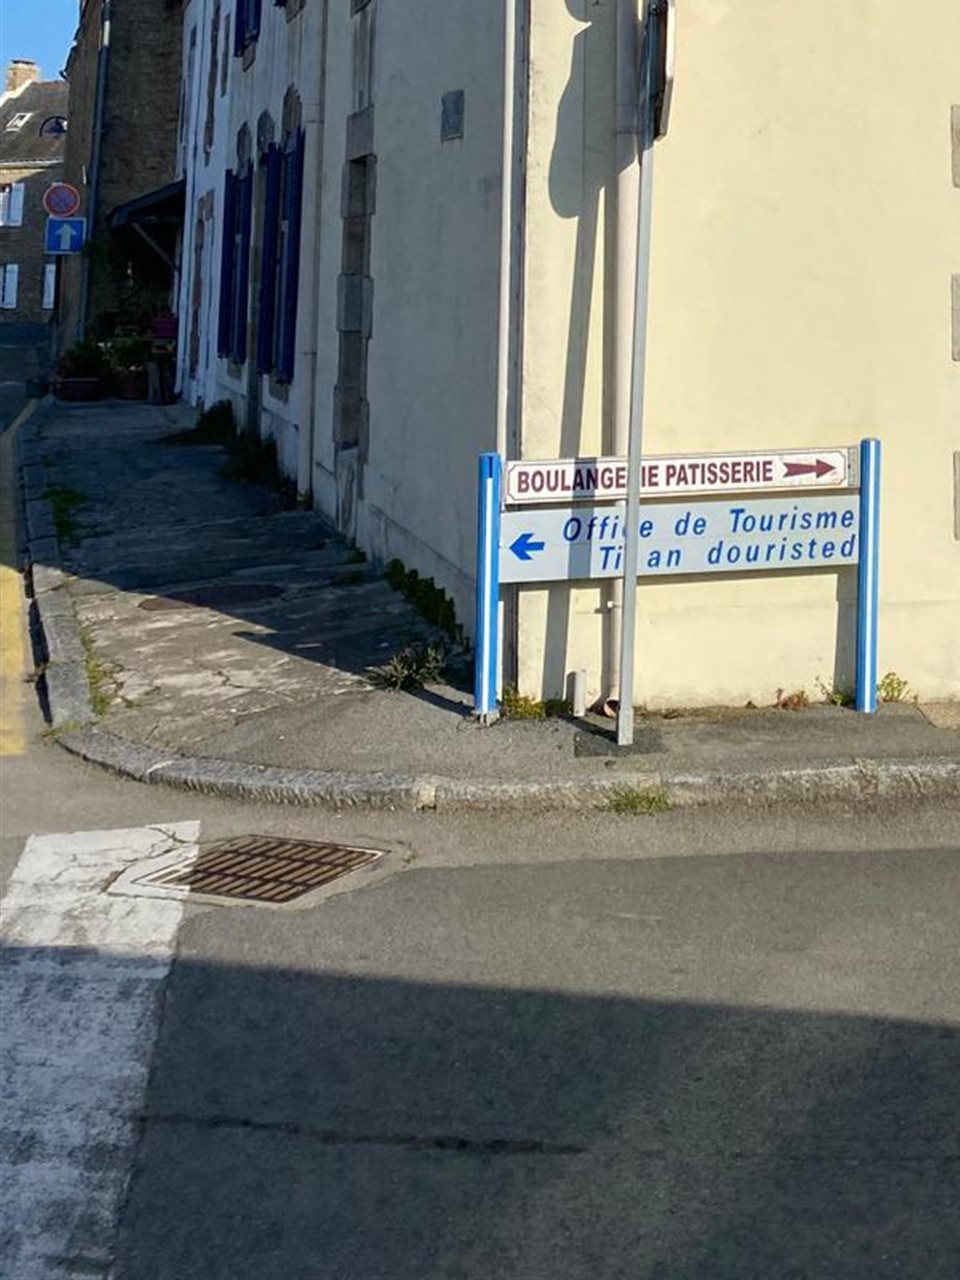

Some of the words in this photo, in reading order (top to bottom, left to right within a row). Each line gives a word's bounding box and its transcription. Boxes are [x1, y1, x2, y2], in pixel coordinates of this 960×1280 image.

[517, 462, 660, 493] BOULANGEIE
[665, 460, 774, 487] PATISSERIE
[674, 512, 707, 536] de
[729, 506, 855, 534] Tourisme
[600, 545, 622, 571] Ti
[647, 548, 681, 569] an
[707, 534, 856, 565] douristed
